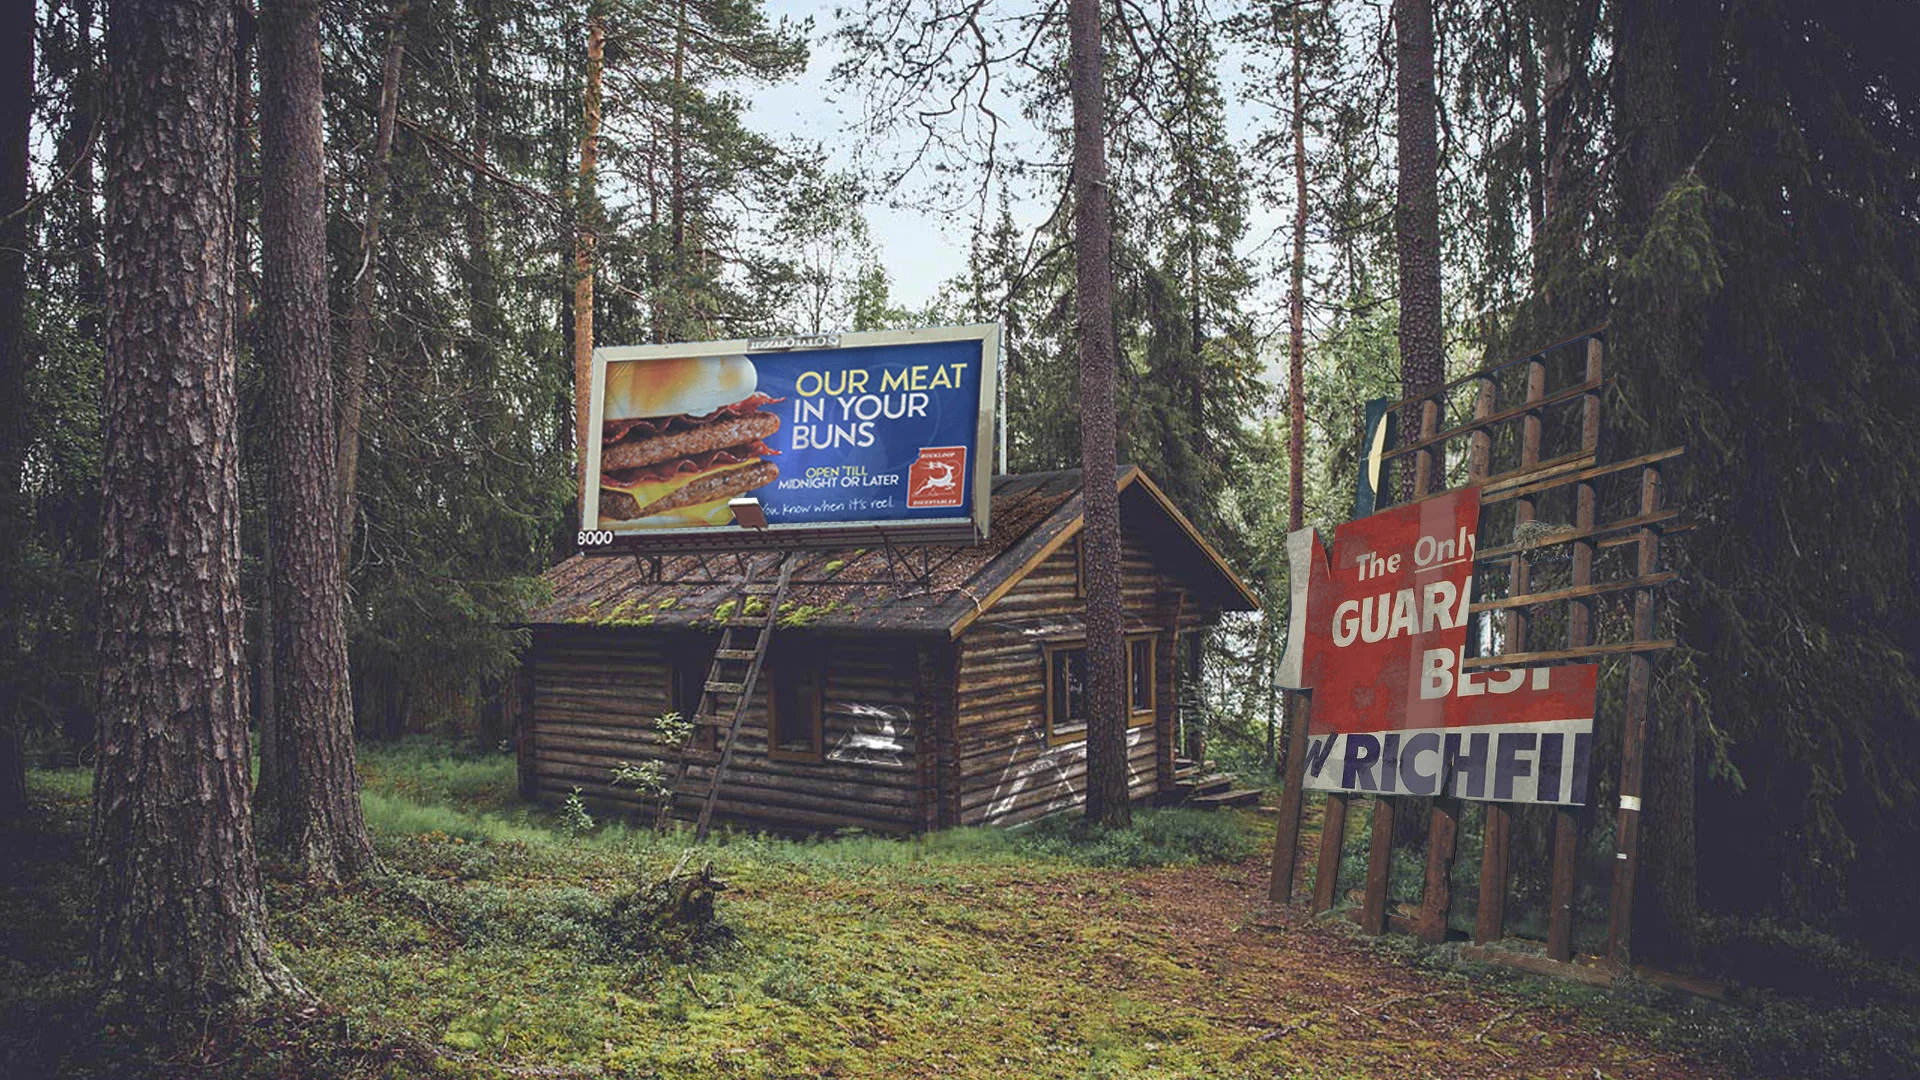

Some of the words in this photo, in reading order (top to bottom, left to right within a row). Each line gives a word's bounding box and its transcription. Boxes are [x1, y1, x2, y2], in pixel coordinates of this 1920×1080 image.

[795, 369, 869, 397] OUR
[880, 363, 967, 393] MEAT
[793, 397, 825, 423] IN
[837, 392, 929, 421] YOUR
[792, 421, 876, 450] BUNS
[778, 476, 837, 490] MIDNIGHT
[840, 476, 860, 488] OR
[862, 474, 899, 486] LATER
[805, 466, 840, 479] OPEN
[814, 499, 845, 513] when
[577, 530, 614, 546] 8000
[1356, 551, 1401, 582] The
